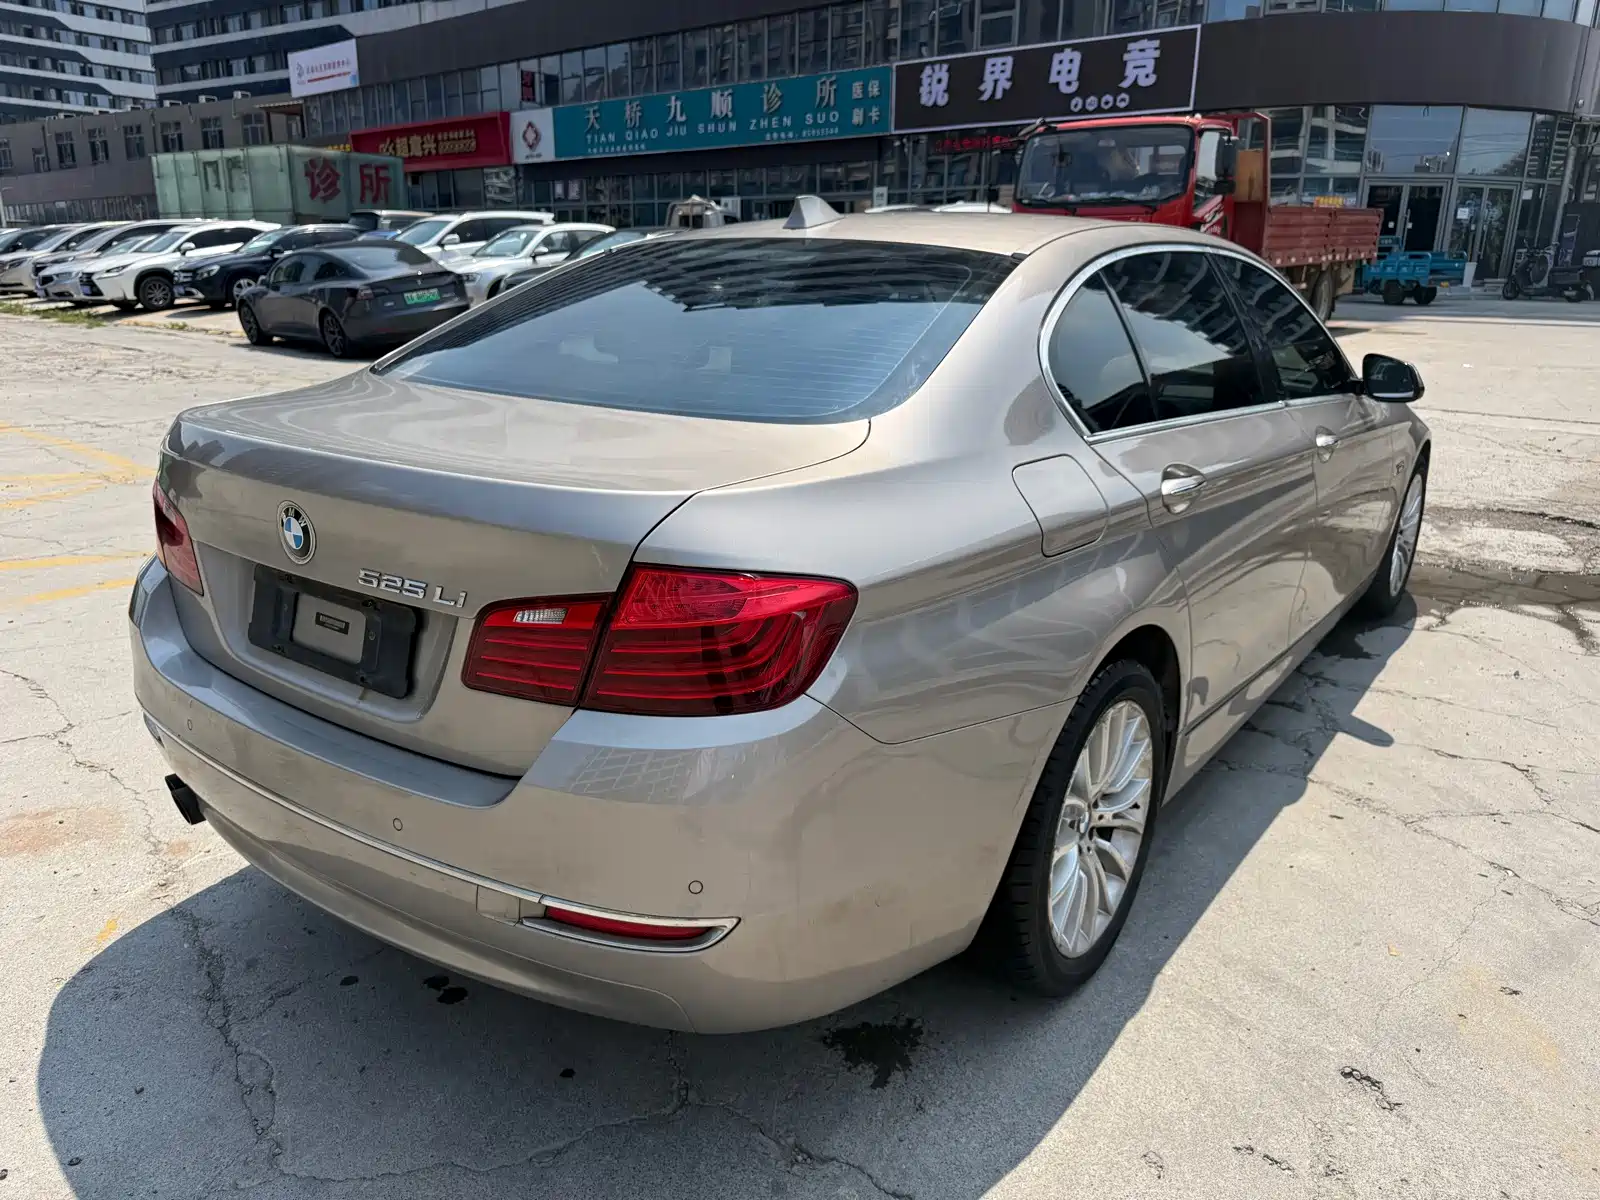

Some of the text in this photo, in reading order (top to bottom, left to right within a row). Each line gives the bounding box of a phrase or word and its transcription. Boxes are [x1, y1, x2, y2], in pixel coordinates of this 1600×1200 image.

[919, 38, 1161, 108] 锐界电竞
[584, 74, 838, 133] 天桥九顺诊所
[586, 111, 839, 145] TIAN QIAO JIU SHUN ZHEN SUO
[304, 157, 391, 204] 诊所
[358, 567, 467, 608] 525 Li
